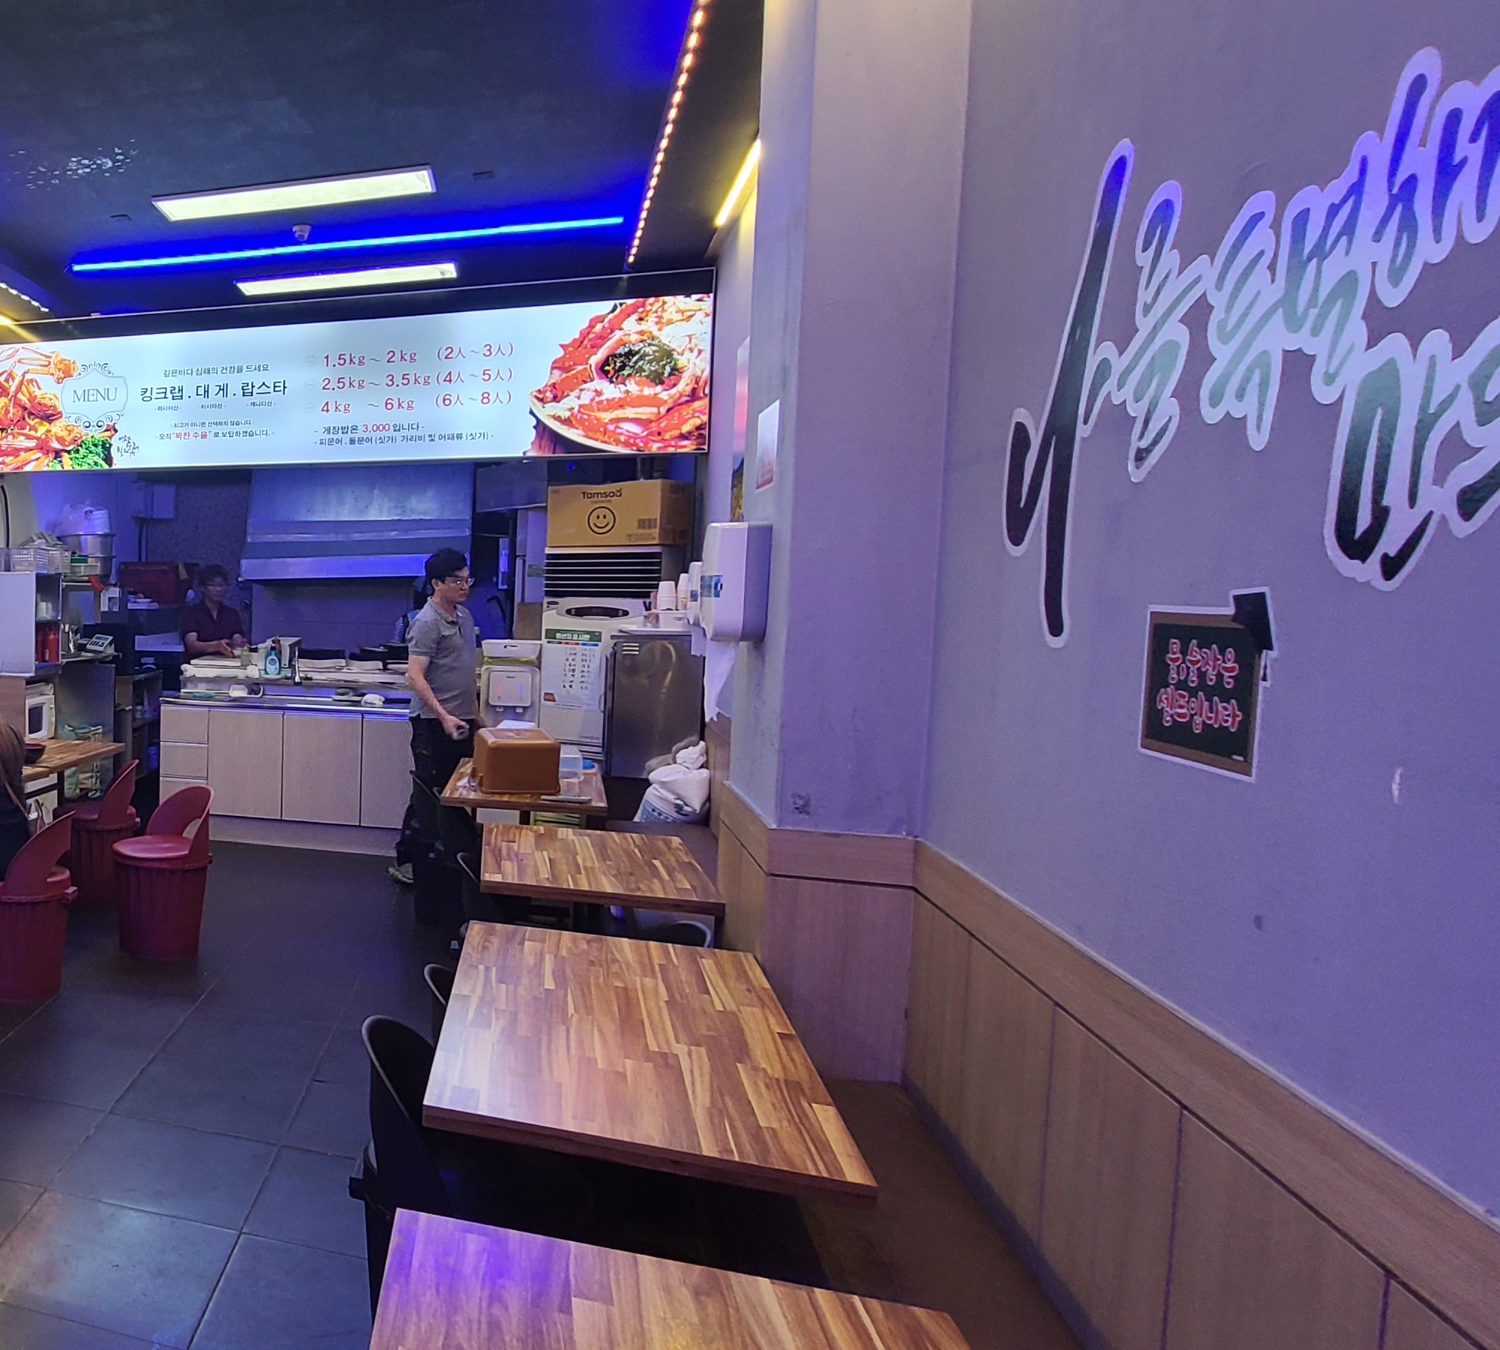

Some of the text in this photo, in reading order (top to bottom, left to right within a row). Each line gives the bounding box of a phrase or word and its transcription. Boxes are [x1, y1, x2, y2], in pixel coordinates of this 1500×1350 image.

[220, 365, 244, 375] 건강을
[246, 363, 269, 373] 드세요
[72, 388, 118, 402] MENU
[140, 386, 184, 402] 킹크랩
[241, 380, 288, 397] 랍스타
[322, 425, 359, 435] 게장밥은
[392, 422, 420, 432] 입니다
[1157, 685, 1242, 733] 셀프입니다
